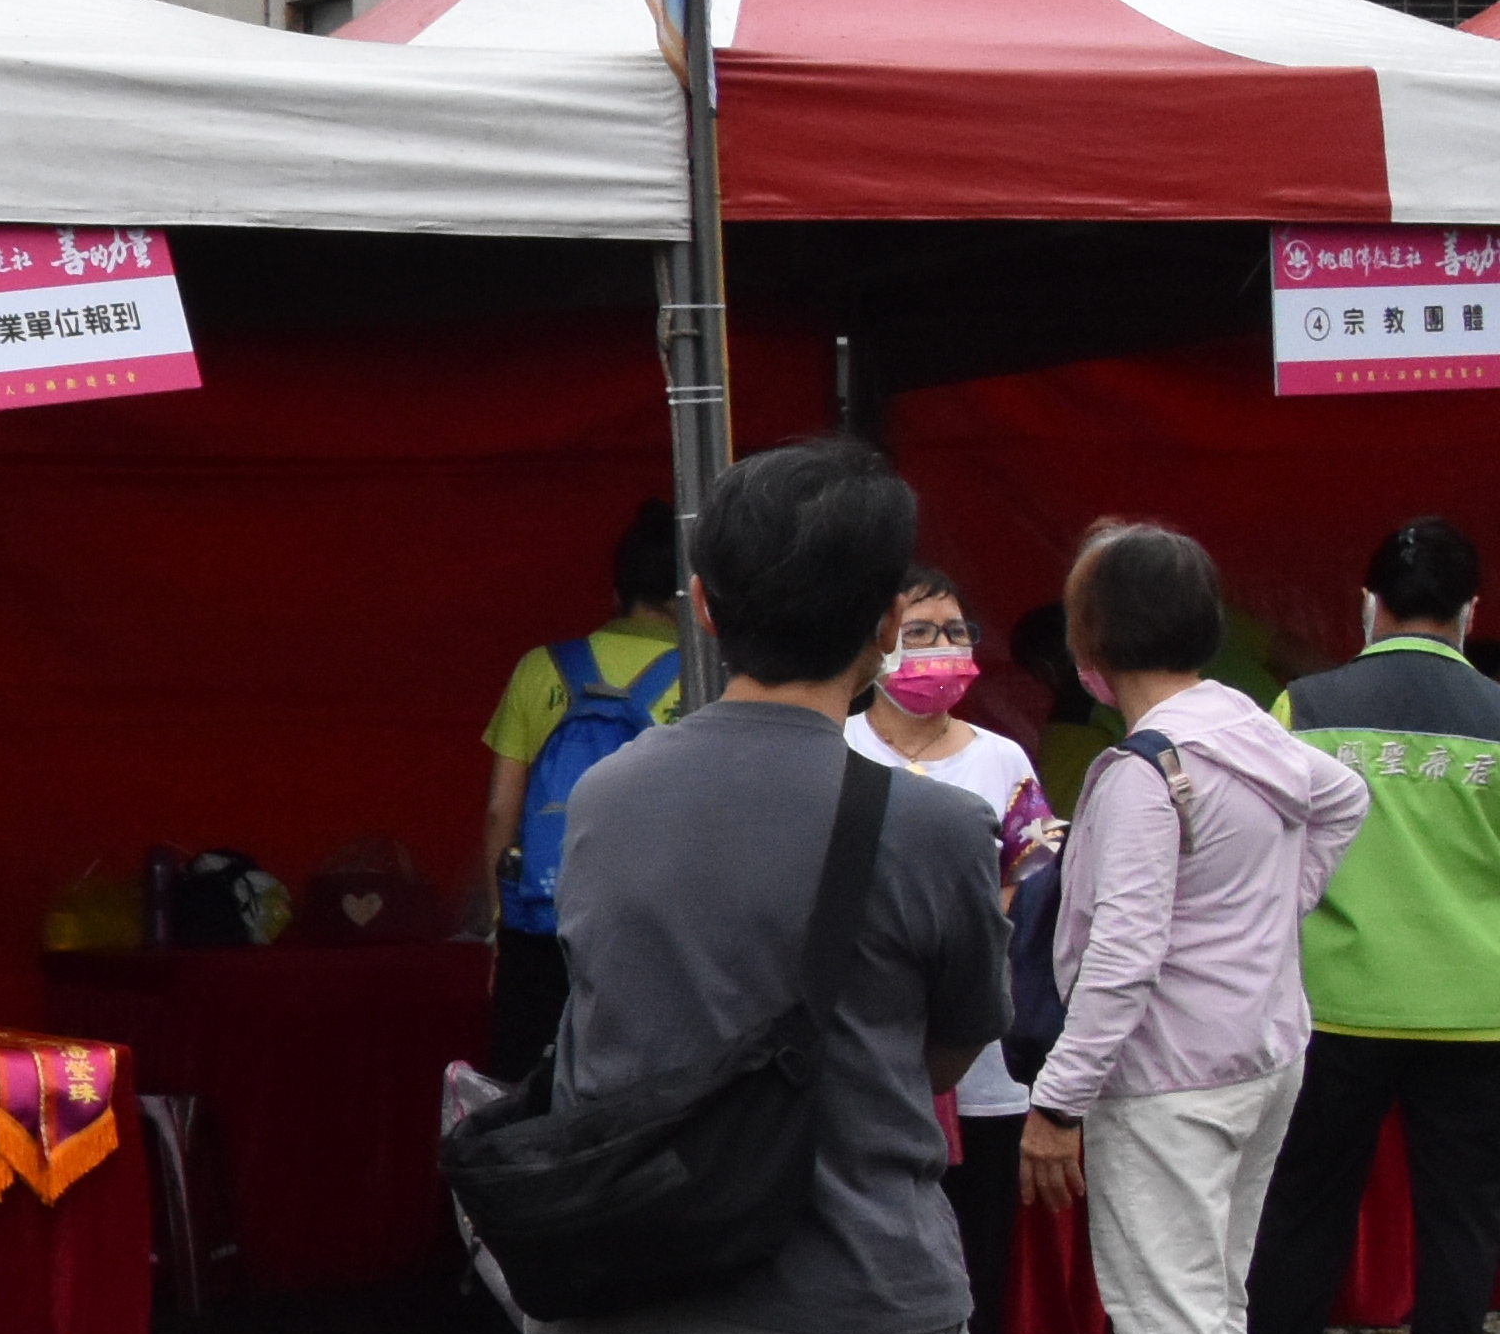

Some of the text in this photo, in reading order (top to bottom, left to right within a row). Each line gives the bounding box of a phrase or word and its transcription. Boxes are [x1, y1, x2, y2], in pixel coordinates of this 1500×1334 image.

[1435, 230, 1500, 277] 善的力
[1342, 304, 1484, 336] 宗教團體
